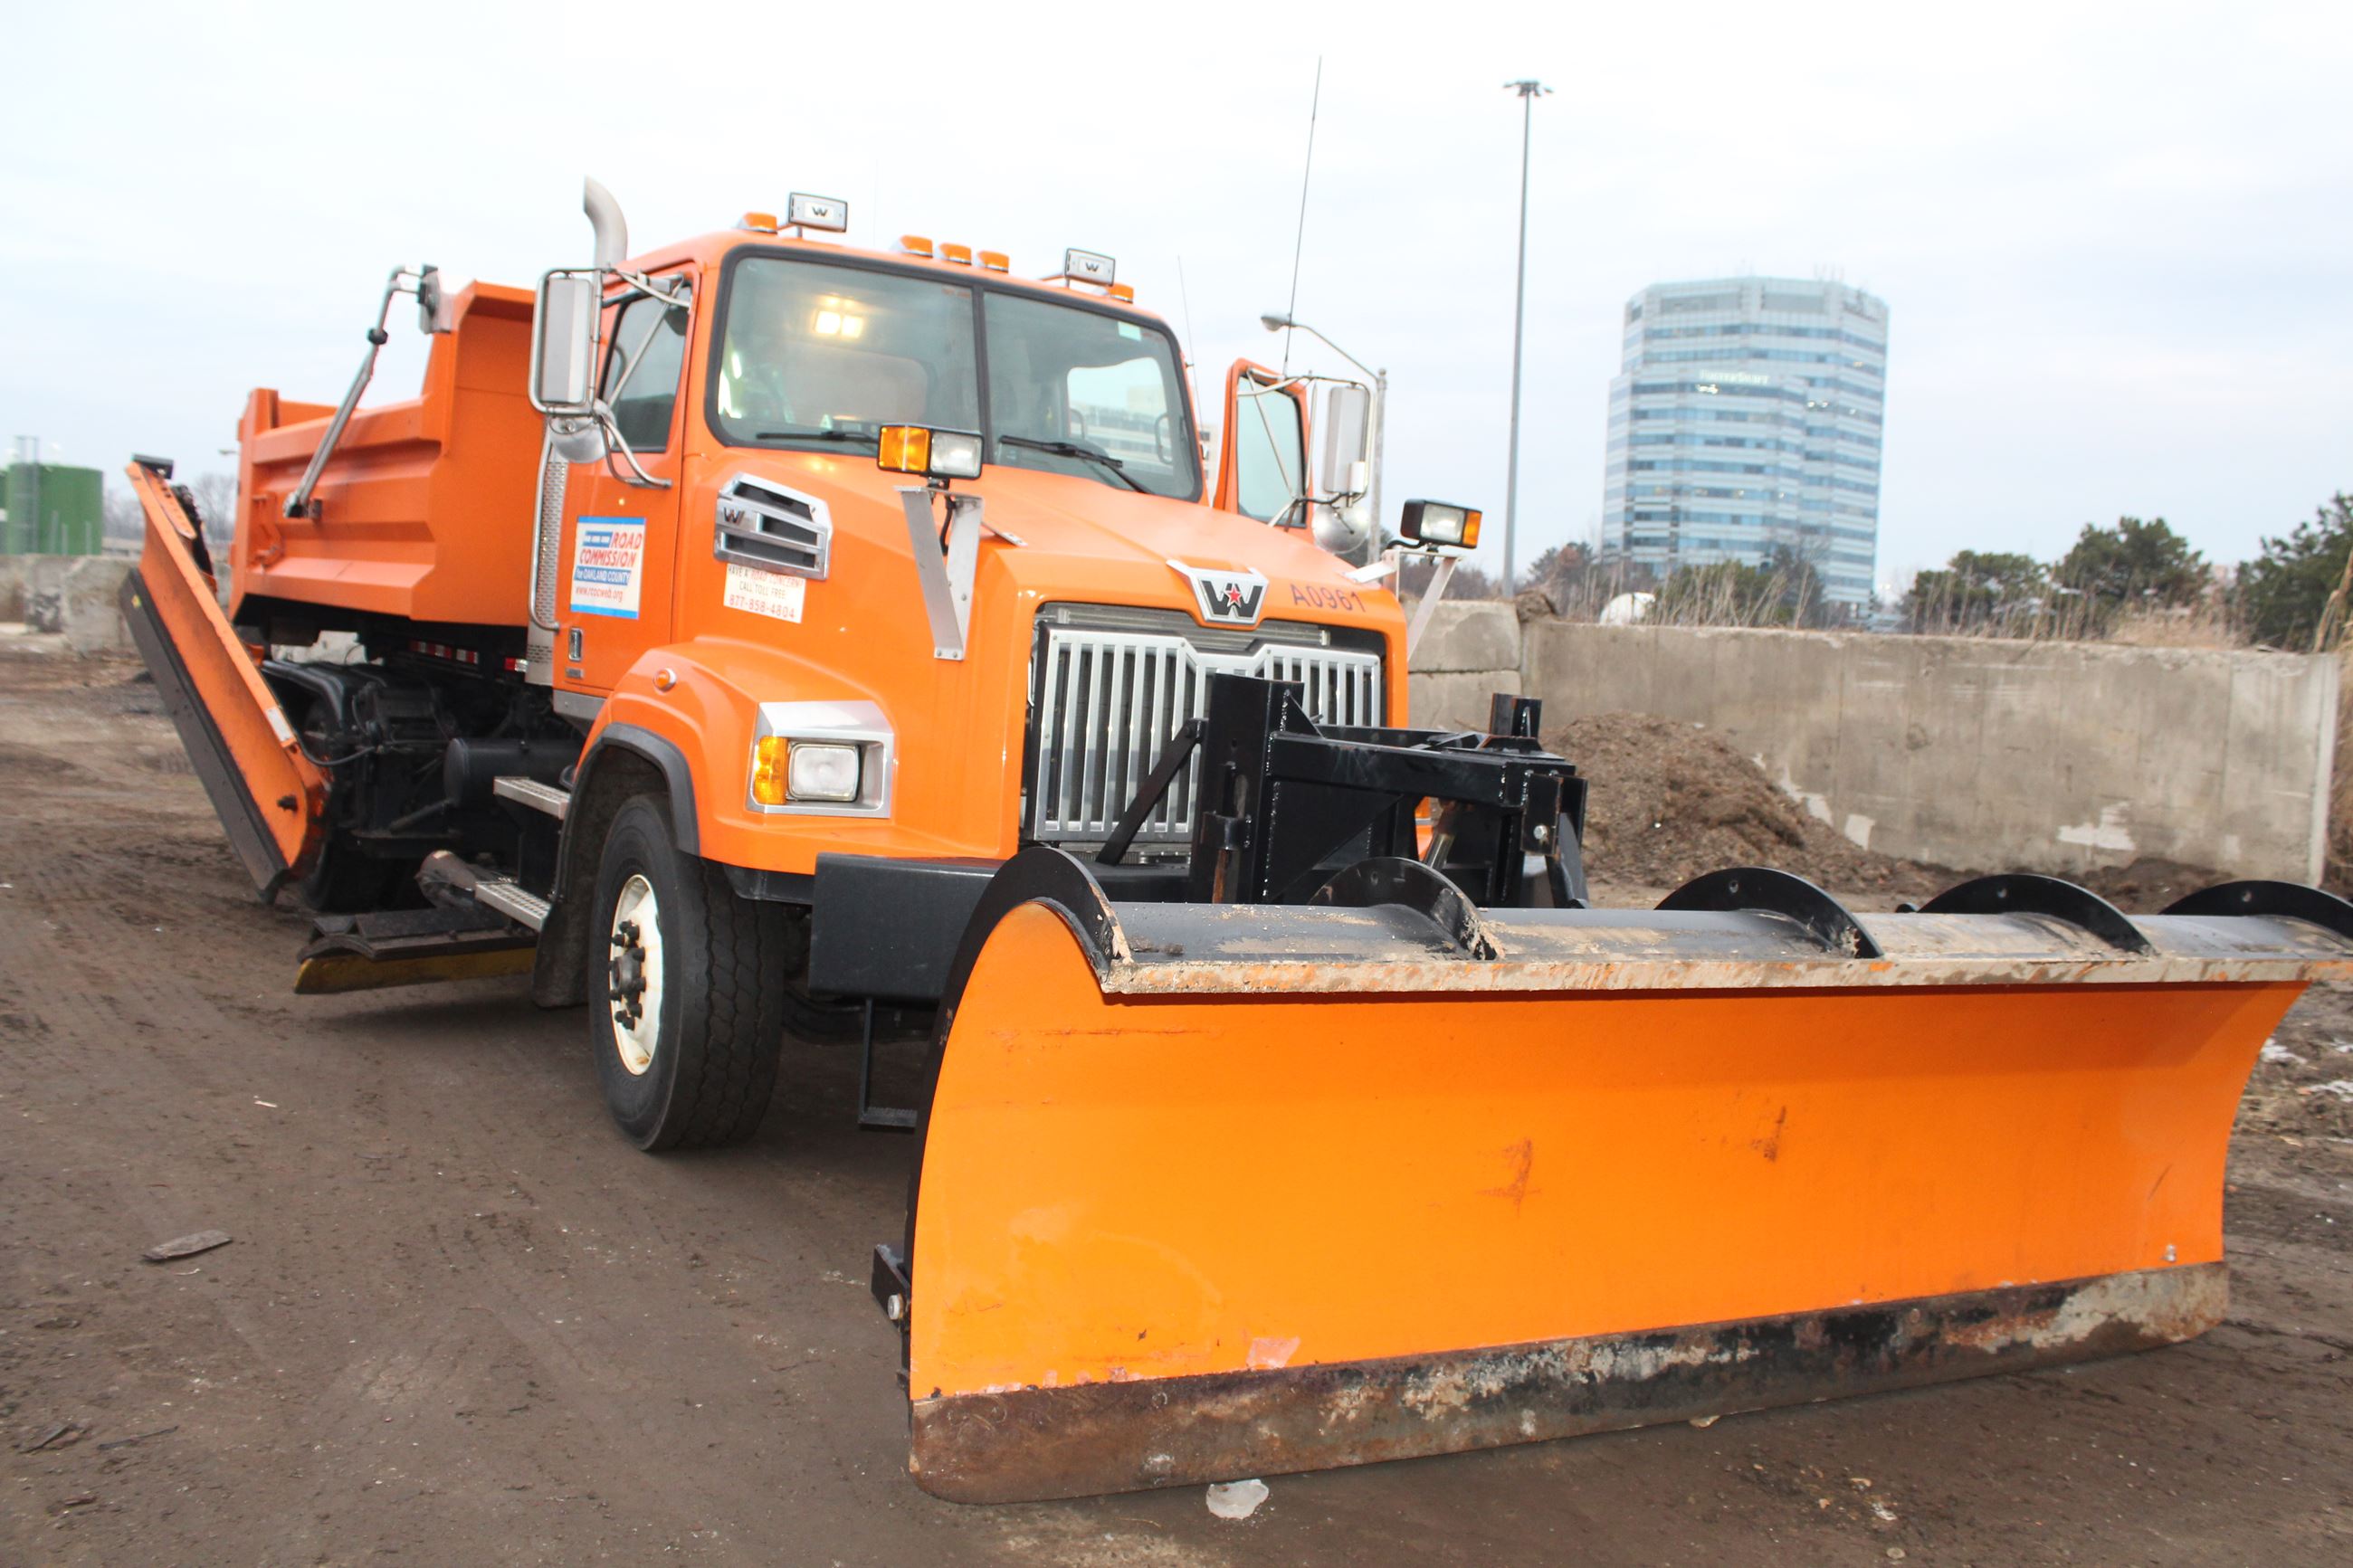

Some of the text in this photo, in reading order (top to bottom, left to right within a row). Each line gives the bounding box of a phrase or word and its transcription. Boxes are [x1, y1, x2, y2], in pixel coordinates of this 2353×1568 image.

[611, 531, 643, 549] ROAD
[580, 548, 636, 567] COMMISSION
[583, 568, 607, 582] OAKLAND
[607, 571, 631, 584] COUNTY
[739, 581, 753, 593] CALL
[755, 584, 768, 595] TOLL
[729, 594, 795, 619] 877-858-4804
[1291, 584, 1367, 613] A0961
